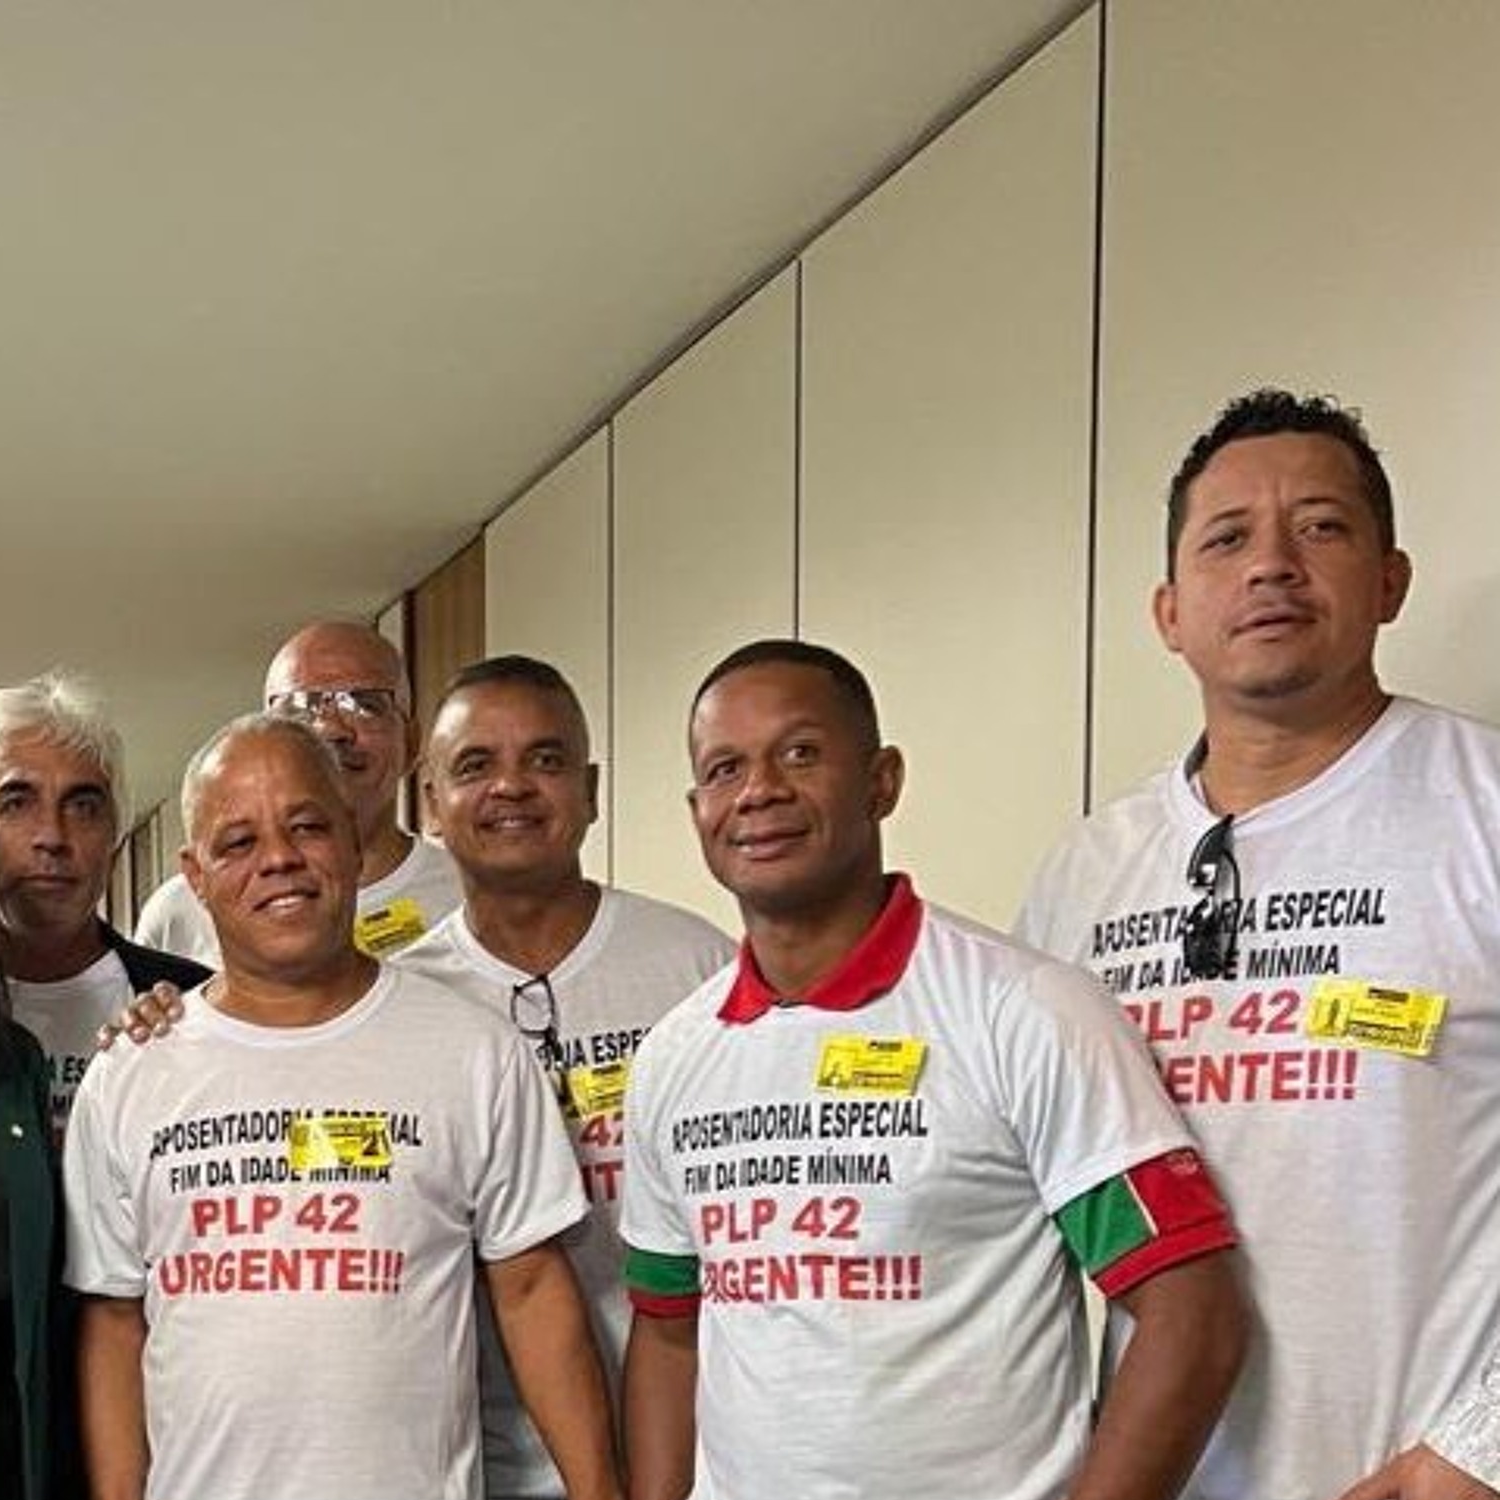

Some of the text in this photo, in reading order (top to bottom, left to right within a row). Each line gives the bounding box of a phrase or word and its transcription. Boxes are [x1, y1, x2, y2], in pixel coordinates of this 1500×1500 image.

[1265, 888, 1386, 933] ESPECIAL
[1139, 959, 1164, 990] DA
[1246, 940, 1340, 979] MÍNIMA
[1228, 989, 1301, 1034] 42
[1167, 1049, 1358, 1104] ENTE!!!
[672, 1099, 928, 1154] APOSENTADORIA ESPECIAL
[170, 1163, 201, 1193] FIM
[206, 1159, 234, 1188] DA
[684, 1147, 892, 1195] FIM DA IDADE MÍNIMA
[191, 1193, 361, 1238] PLP 42
[701, 1195, 862, 1246] PLP 42
[160, 1248, 405, 1296] URGENTE!!!
[701, 1253, 923, 1304] RGENTE!!!
